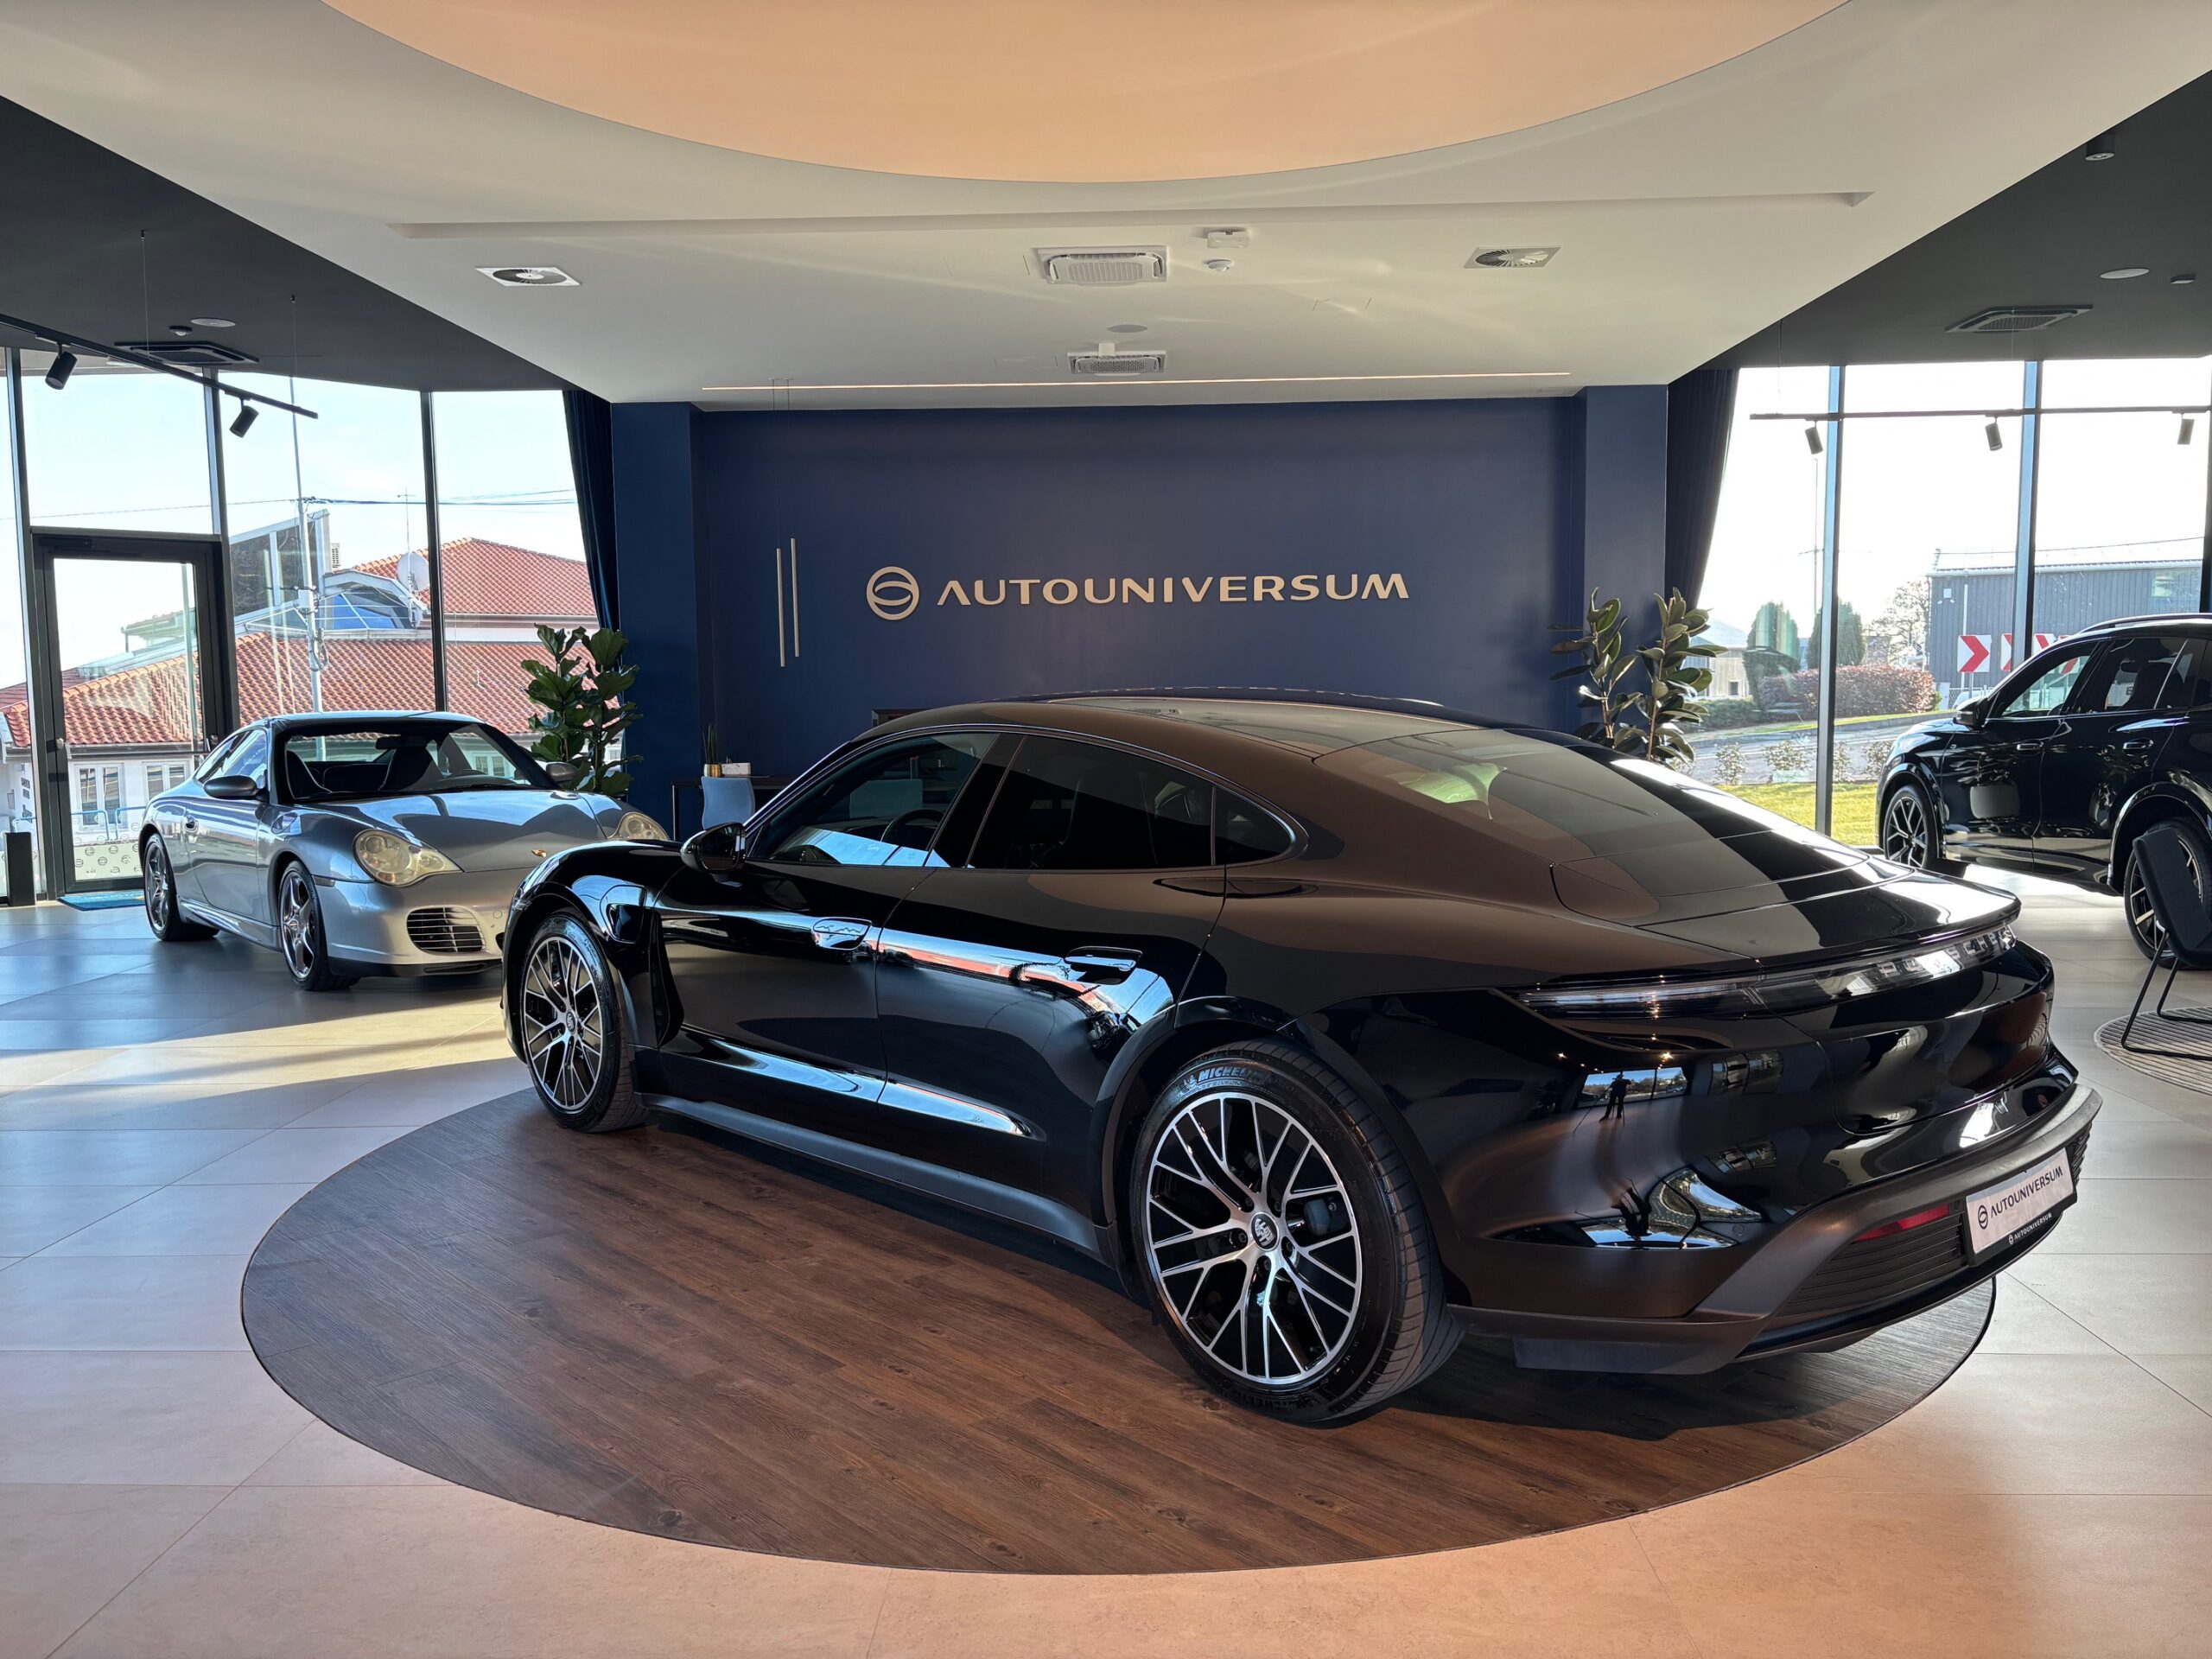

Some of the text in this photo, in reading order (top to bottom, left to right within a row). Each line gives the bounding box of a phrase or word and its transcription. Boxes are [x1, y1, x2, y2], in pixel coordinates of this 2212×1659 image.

[937, 573, 1409, 607] AUTOUNIVERSUM
[1877, 932, 1999, 978] POSCHE
[1990, 1166, 2063, 1218] AUTOUNIVERSUM
[2013, 1211, 2053, 1241] AUTOUNIVERSUM
